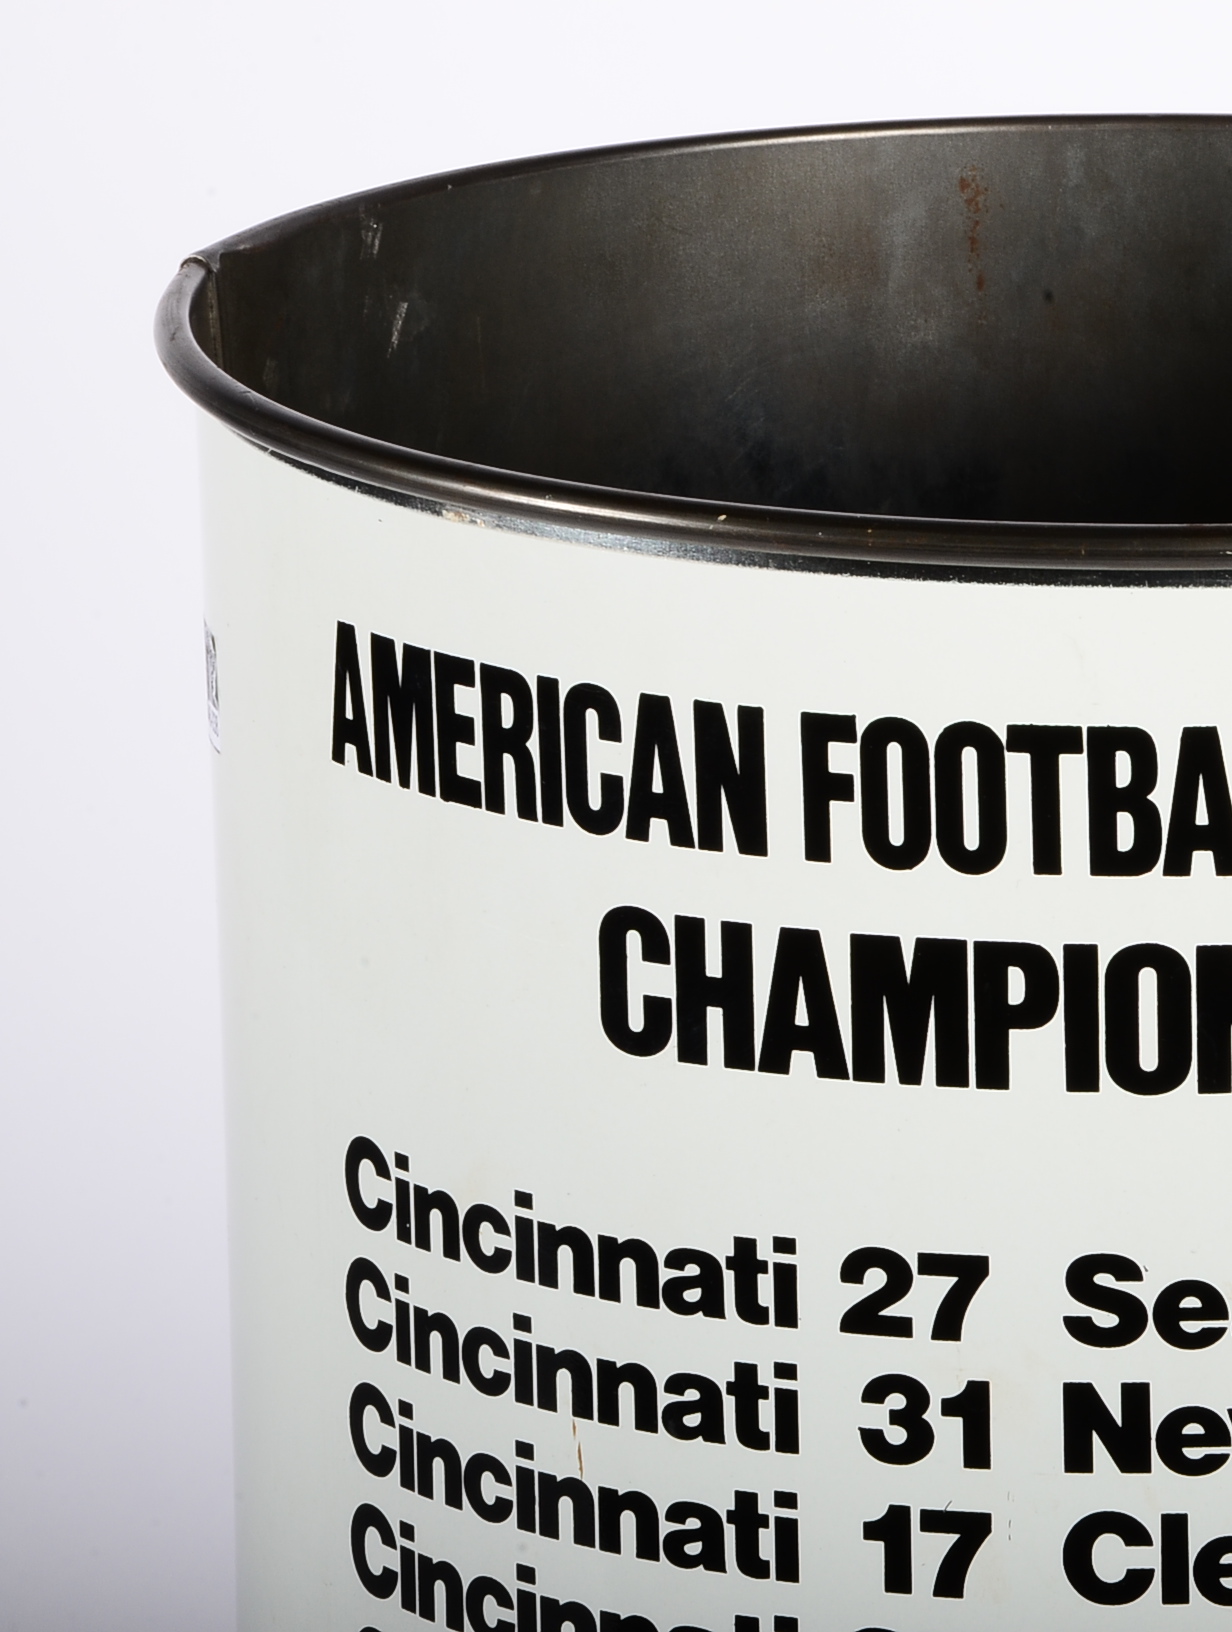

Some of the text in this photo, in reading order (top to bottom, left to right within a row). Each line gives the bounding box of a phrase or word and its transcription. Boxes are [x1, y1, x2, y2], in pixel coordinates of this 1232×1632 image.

[332, 621, 768, 858] AMERICAN
[344, 1136, 797, 1329] Cincinnati
[839, 1246, 990, 1342] 27
[345, 1257, 799, 1452] Cincinnati
[857, 1373, 992, 1470] 31
[349, 1381, 800, 1580] Cincinnati
[862, 1504, 993, 1599] 17
